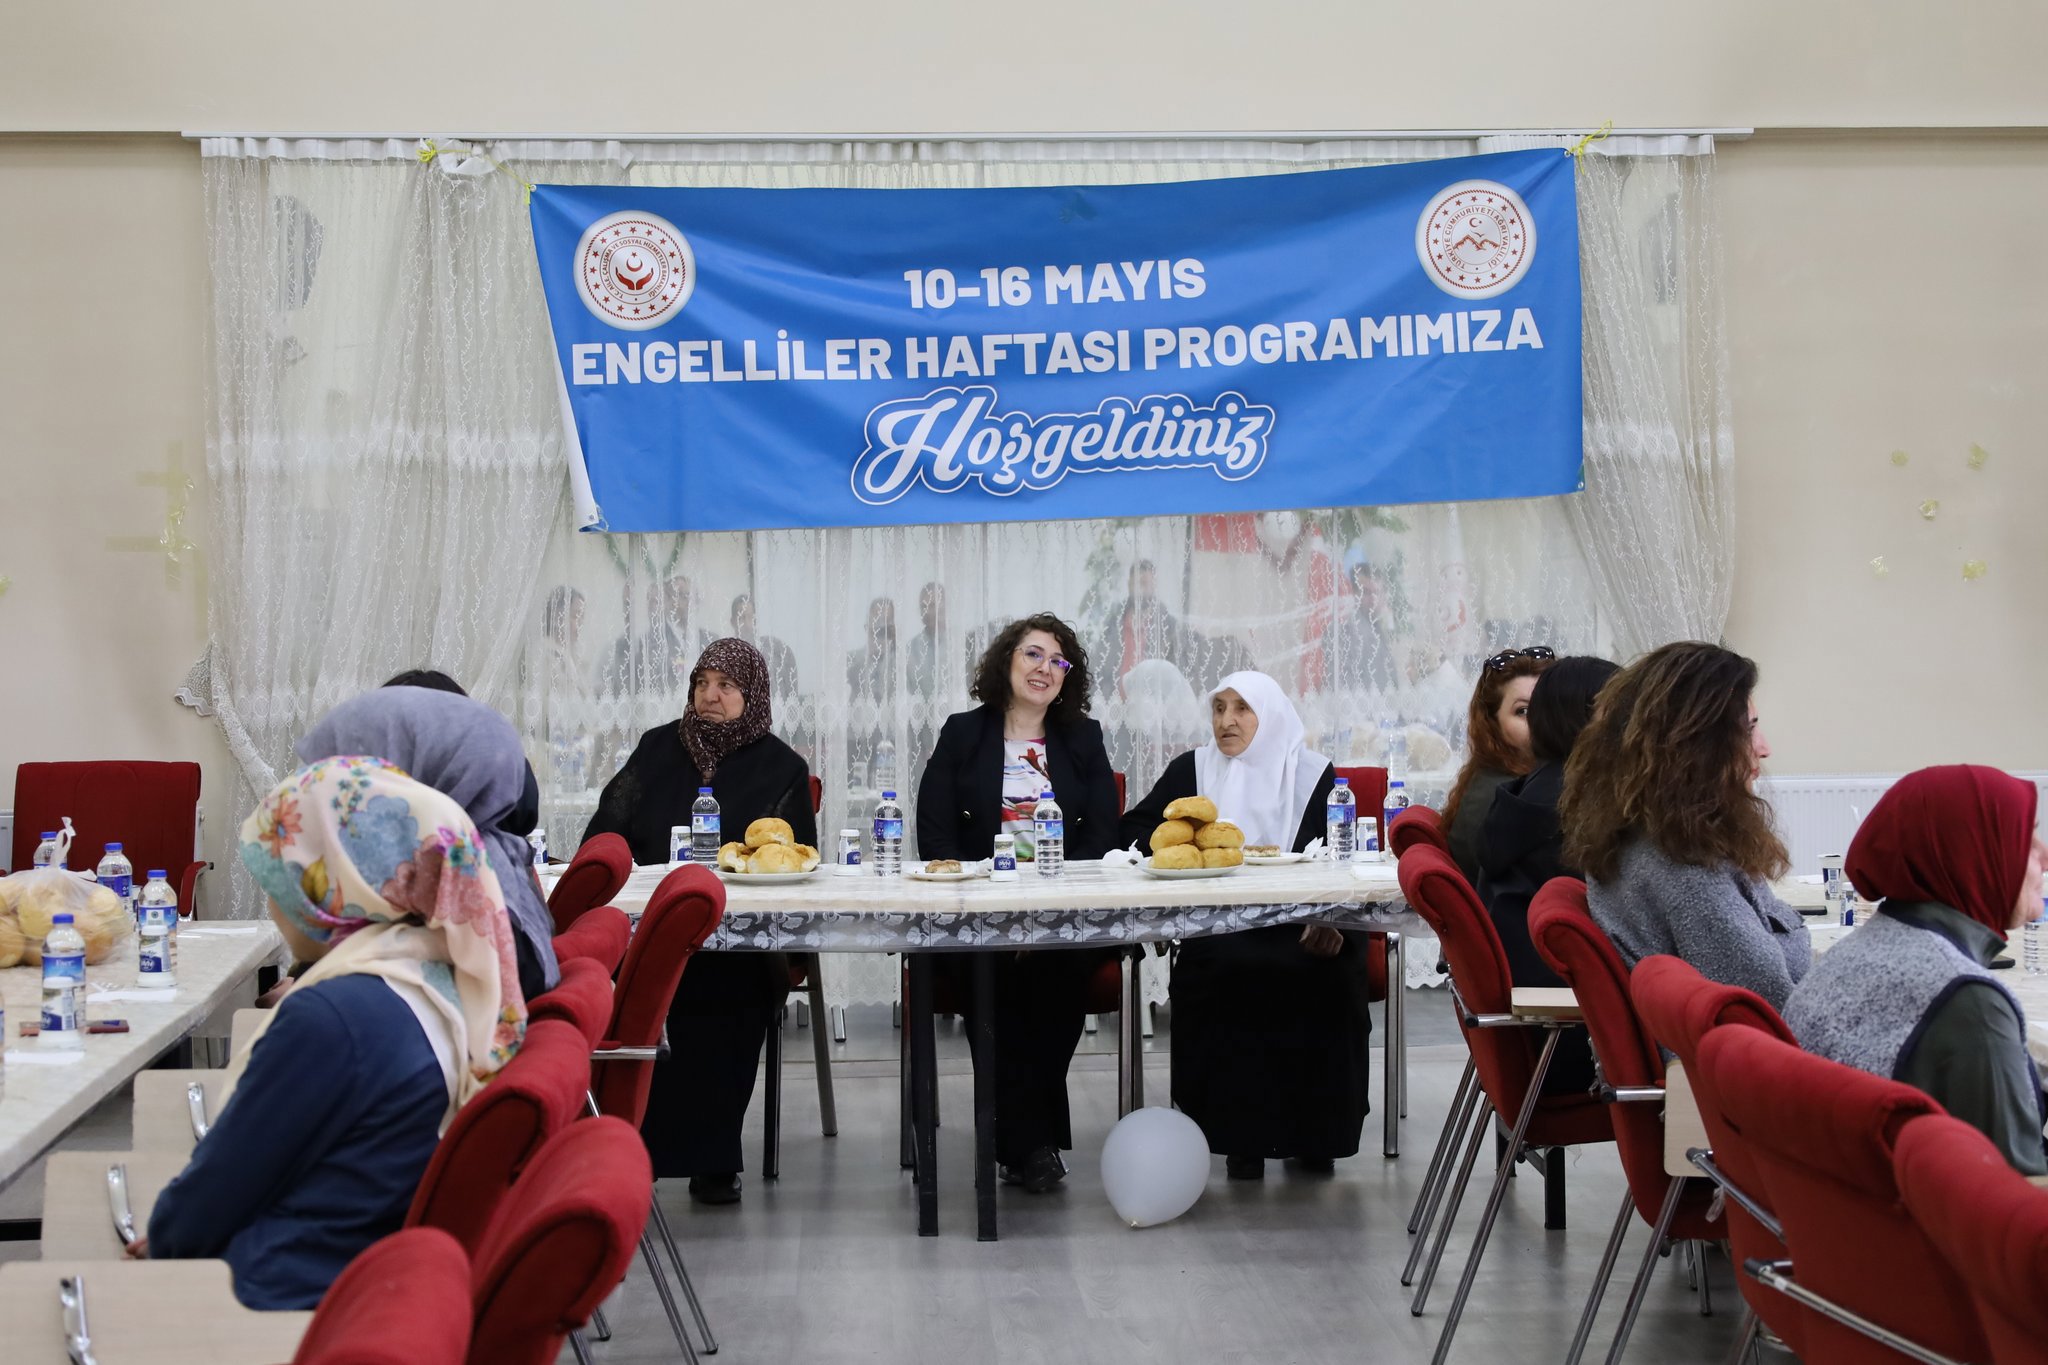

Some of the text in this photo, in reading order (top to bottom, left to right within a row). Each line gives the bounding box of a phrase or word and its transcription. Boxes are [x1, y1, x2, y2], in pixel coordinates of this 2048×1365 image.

[1044, 259, 1206, 306] MAYIS
[572, 308, 1544, 385] ENGELLİLER HAFTASI PROGRAMIMIZA
[863, 396, 1265, 494] Hoşgeldiniz
